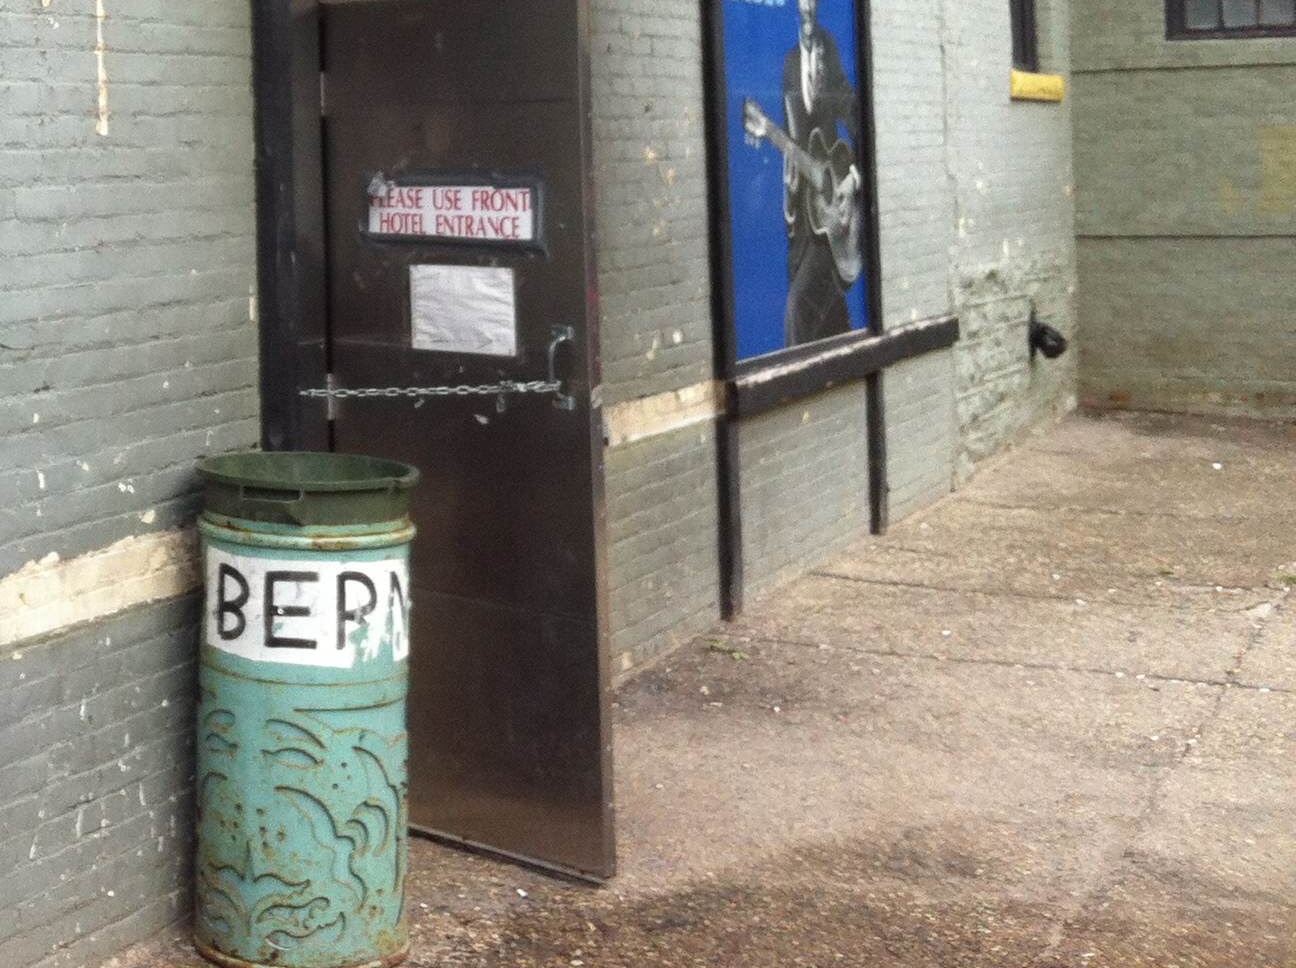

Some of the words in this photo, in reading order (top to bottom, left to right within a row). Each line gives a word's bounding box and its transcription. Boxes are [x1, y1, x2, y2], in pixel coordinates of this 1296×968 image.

[432, 188, 461, 211] USE
[472, 188, 530, 213] FRONT
[379, 212, 426, 235] HOTEL
[435, 214, 520, 238] ENTRANCE
